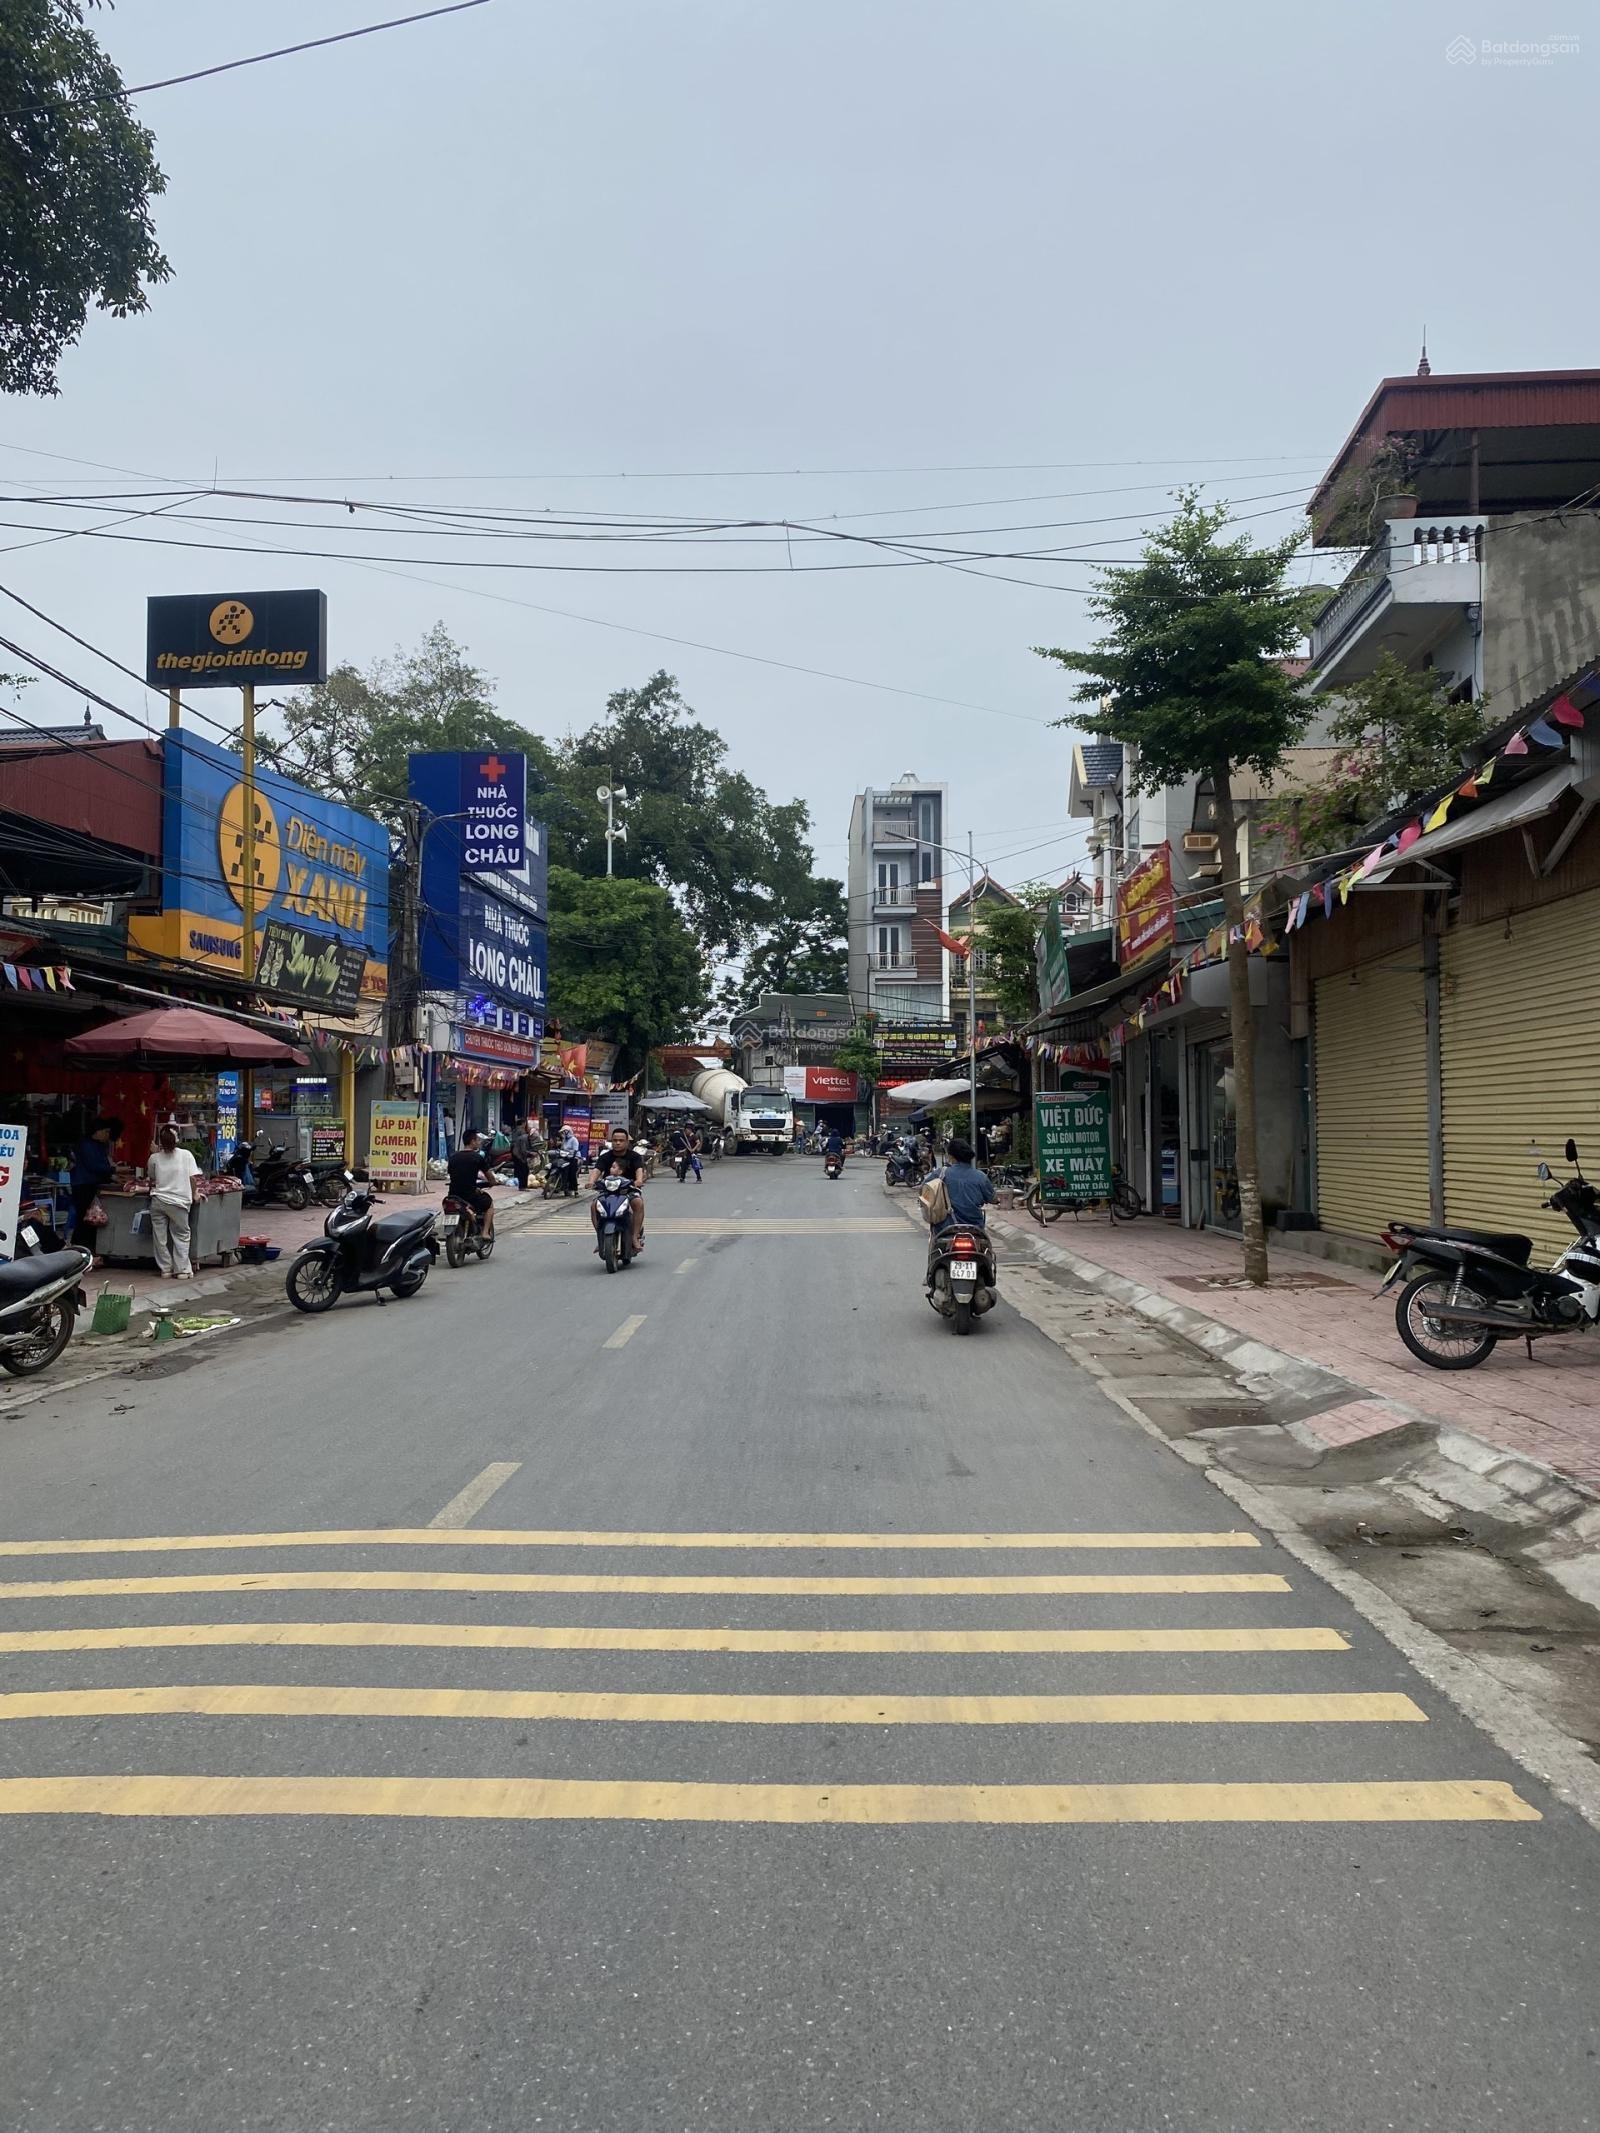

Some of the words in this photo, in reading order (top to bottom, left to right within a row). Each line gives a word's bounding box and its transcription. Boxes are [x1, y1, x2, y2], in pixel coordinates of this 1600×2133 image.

[156, 649, 309, 673] thegioididong
[477, 784, 508, 799] NHÀ
[467, 802, 518, 819] THUỐC
[466, 824, 519, 840] LONG
[285, 816, 328, 862] Điện
[330, 841, 367, 881] máy
[465, 844, 520, 864] CHÂU
[280, 862, 368, 932] XANH
[484, 904, 503, 936] NHÀ
[504, 916, 530, 948] THUỐC
[189, 930, 242, 960] SAMSUNG
[469, 938, 506, 988] LONG
[508, 955, 541, 1000] CHÂU
[812, 1076, 851, 1085] viettel
[375, 1116, 395, 1130] LẮP
[398, 1118, 417, 1132] ĐẶT
[1040, 1105, 1070, 1131] VIỆT
[1074, 1104, 1104, 1126] ĐỨC
[374, 1135, 417, 1146] CAMERA
[1075, 1131, 1100, 1143] MOTOR
[391, 1151, 417, 1165] 390K
[1045, 1158, 1065, 1173] XE
[1069, 1155, 1104, 1172] MÁY
[1093, 1173, 1105, 1181] XE
